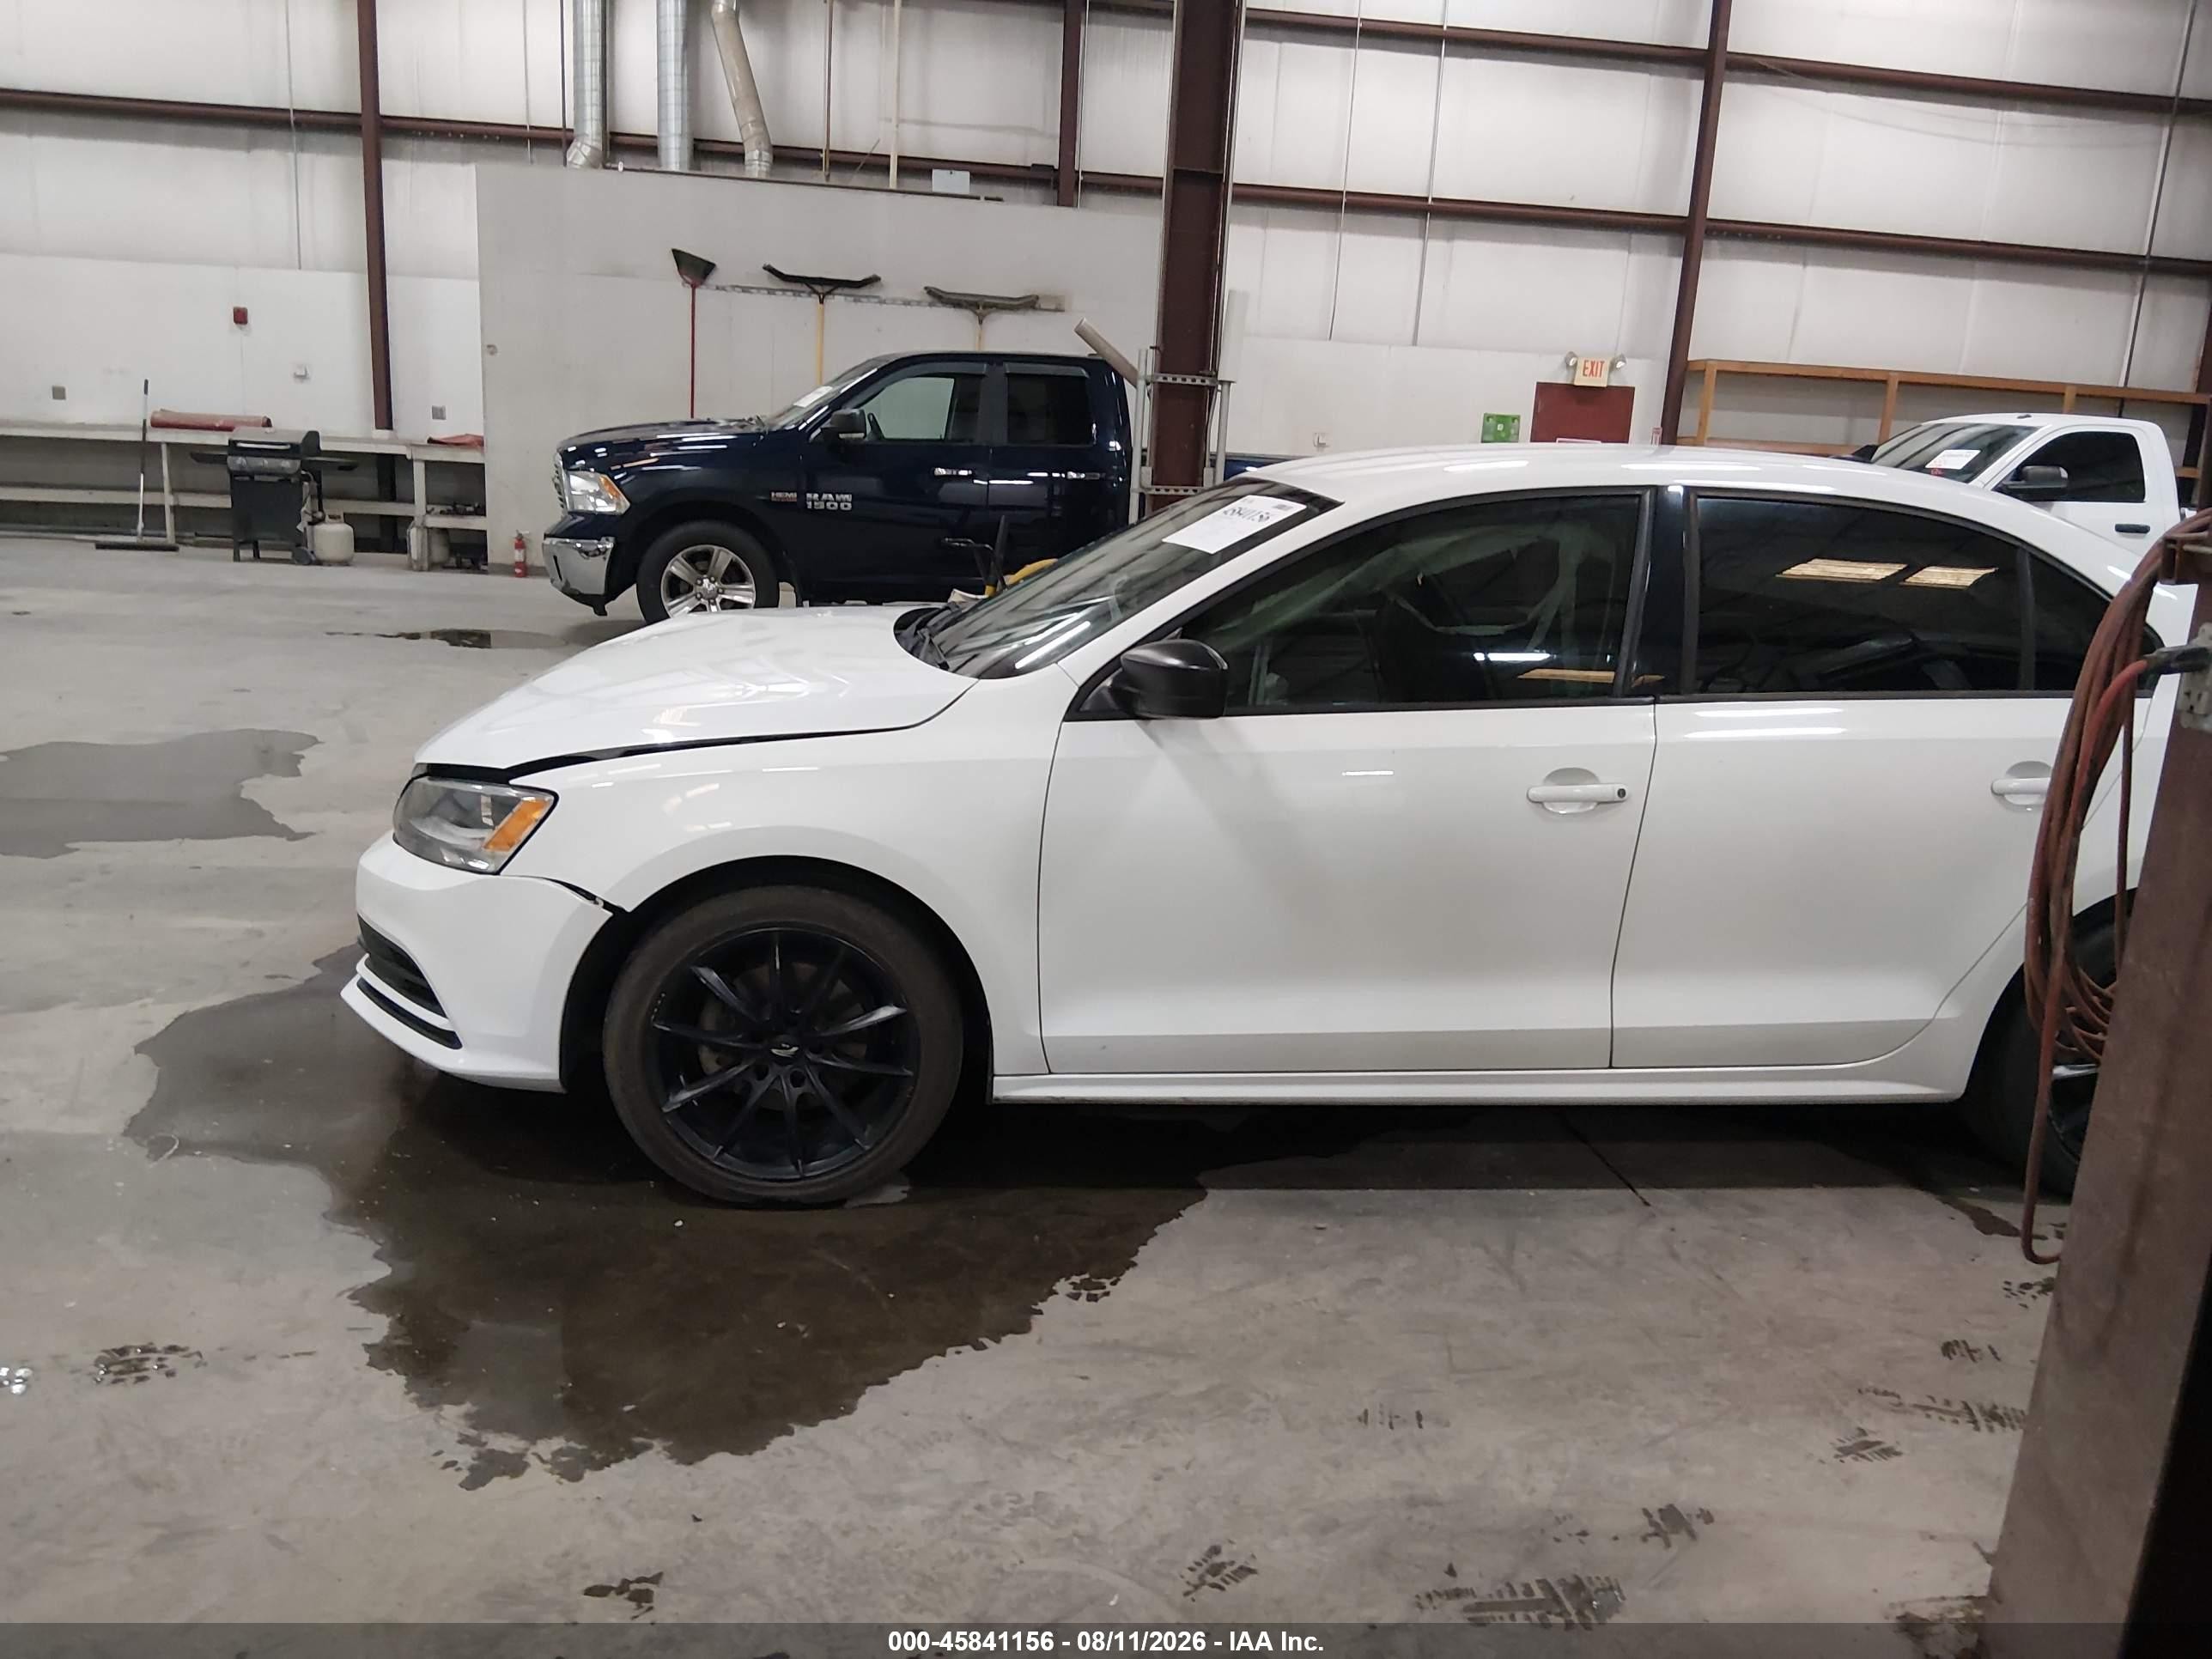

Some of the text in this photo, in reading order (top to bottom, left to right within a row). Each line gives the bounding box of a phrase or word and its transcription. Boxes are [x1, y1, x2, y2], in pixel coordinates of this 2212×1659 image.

[1583, 360, 1605, 378] EXIT
[806, 493, 852, 501] RAM
[806, 501, 852, 510] 1500
